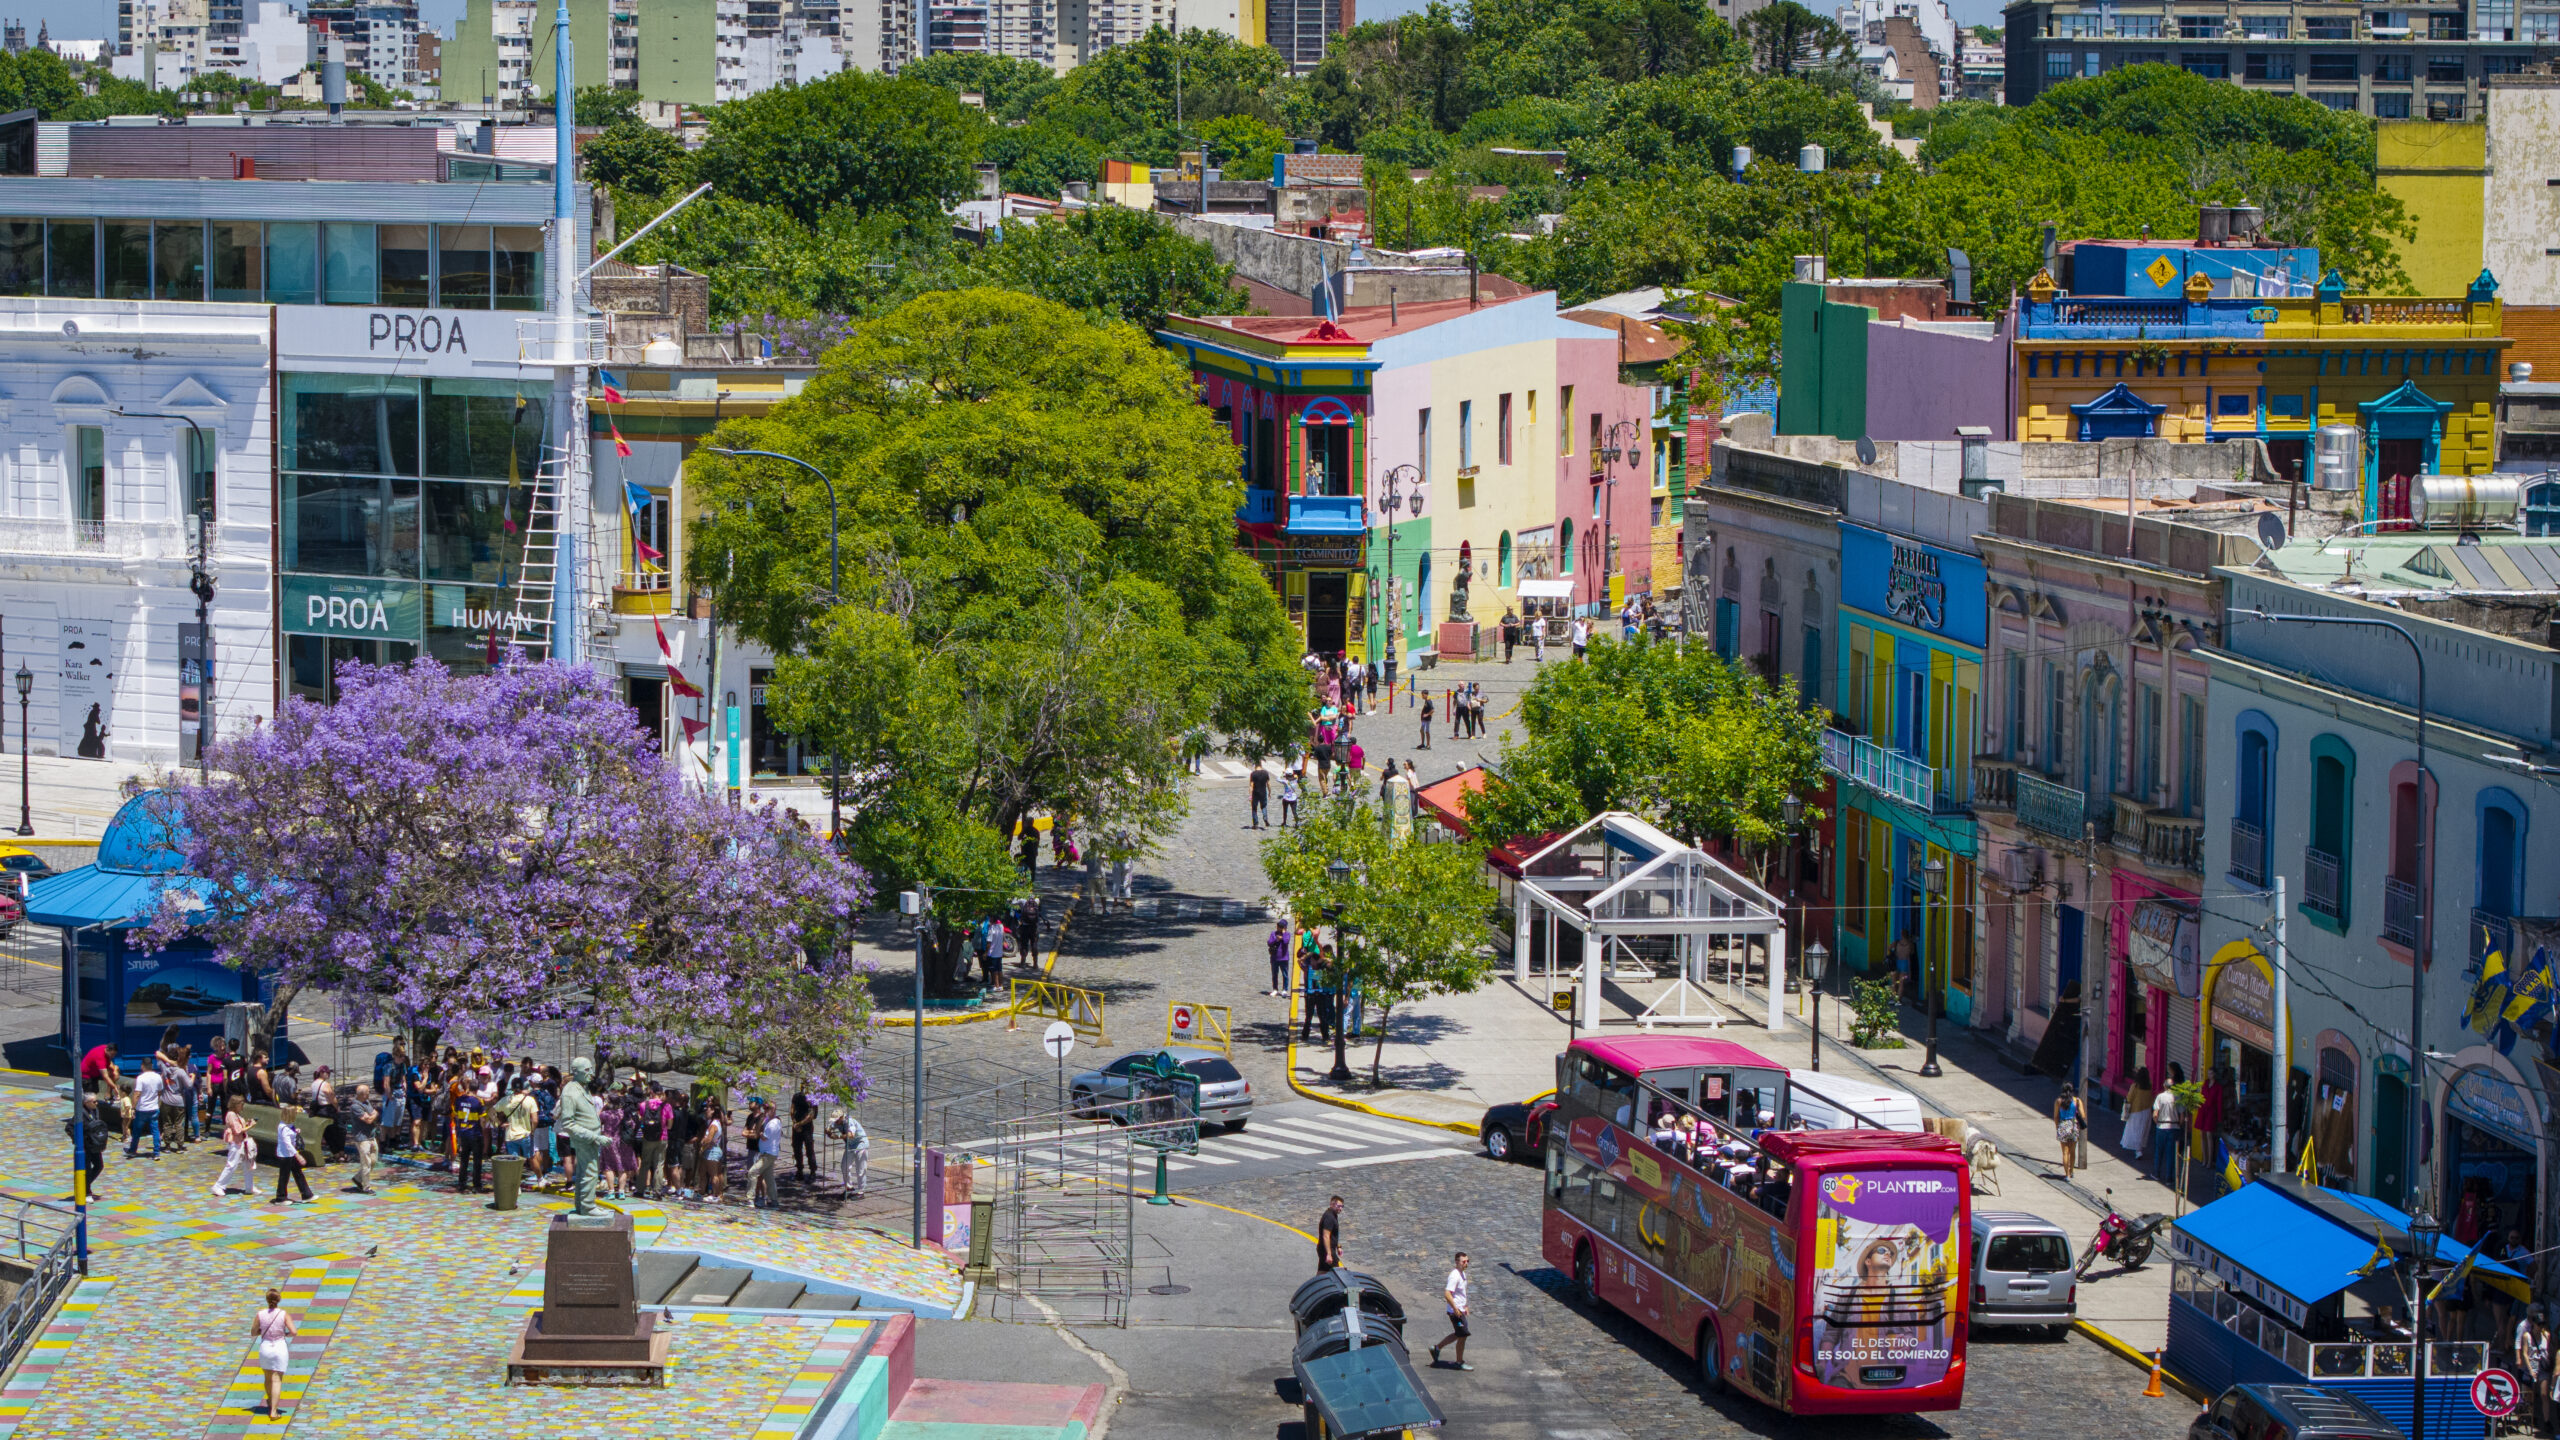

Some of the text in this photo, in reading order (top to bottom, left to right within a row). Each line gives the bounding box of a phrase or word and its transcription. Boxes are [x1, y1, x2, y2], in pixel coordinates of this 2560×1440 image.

[370, 314, 467, 354] PROA
[1892, 546, 1938, 577] PARRILLA
[308, 595, 389, 631] PROA
[453, 608, 532, 632] HUMAN
[63, 625, 83, 634] PROA
[184, 636, 209, 647] PRO
[65, 659, 83, 669] Kara
[65, 671, 91, 681] Walker
[1824, 1180, 1836, 1191] 60
[1561, 1229, 1573, 1249] 4072
[1852, 1338, 1919, 1348] EL DESTINO
[1818, 1350, 1949, 1360] ES SOLO EL COMIENZO
